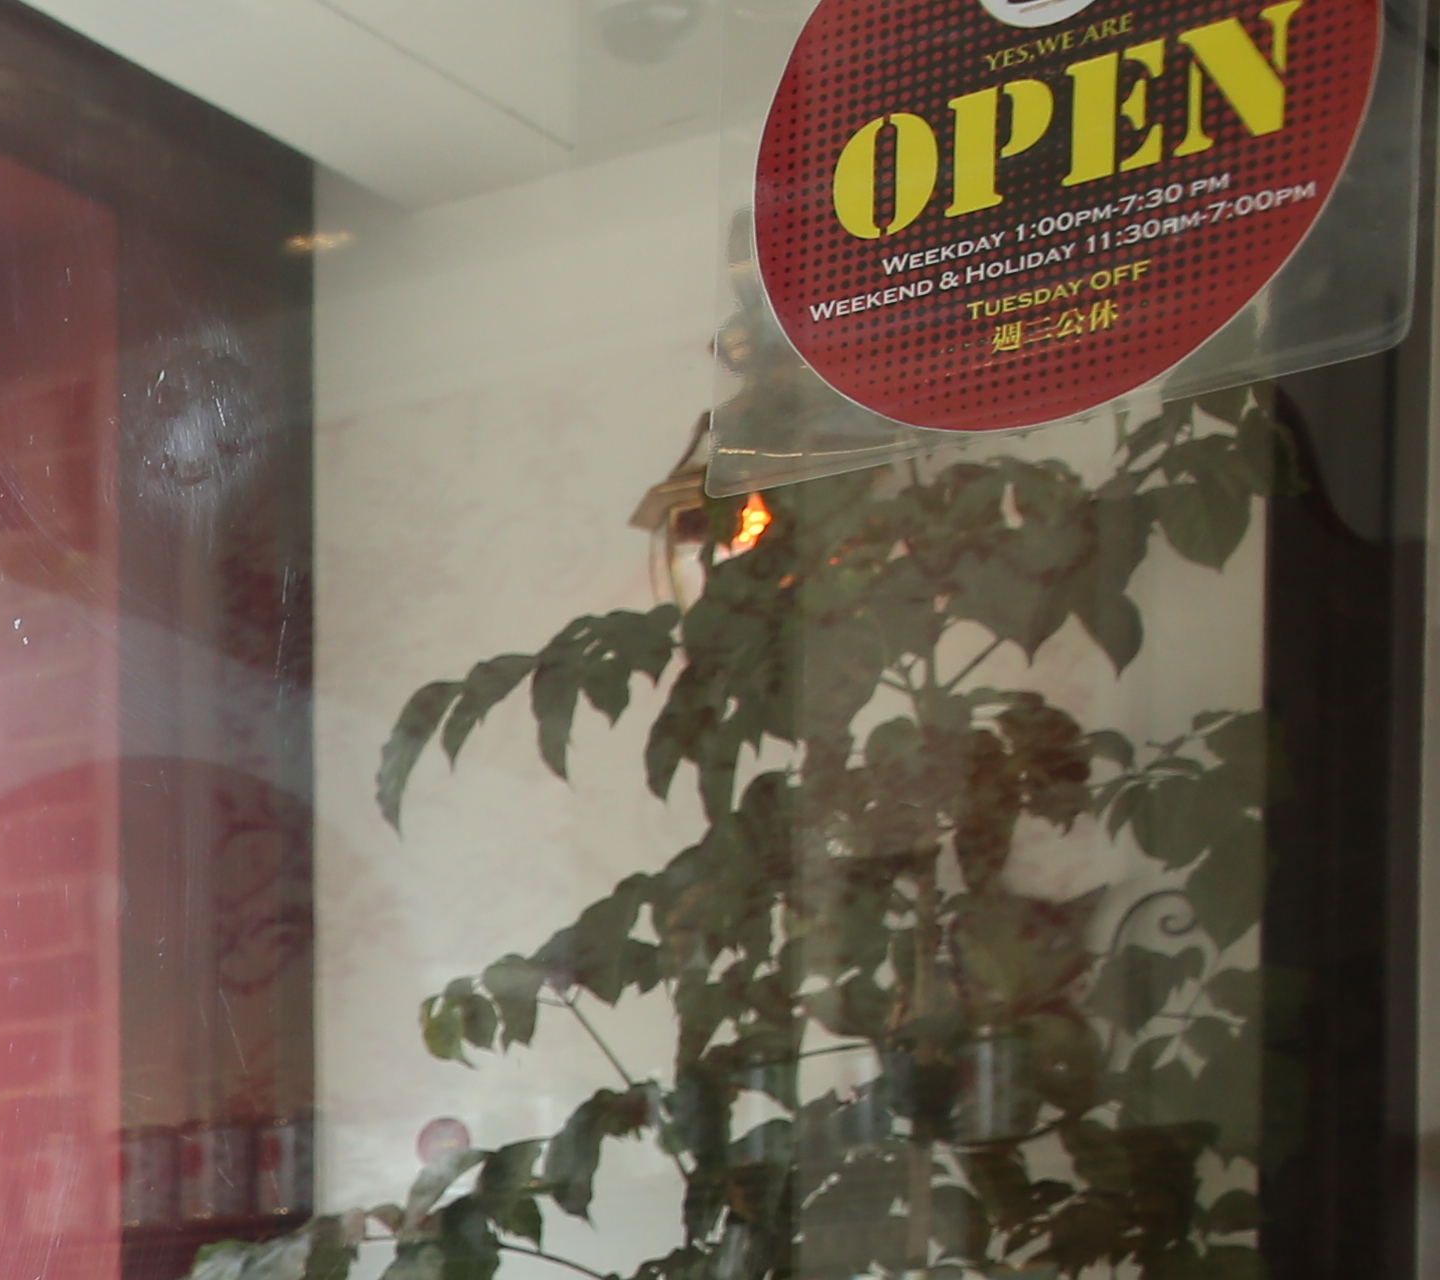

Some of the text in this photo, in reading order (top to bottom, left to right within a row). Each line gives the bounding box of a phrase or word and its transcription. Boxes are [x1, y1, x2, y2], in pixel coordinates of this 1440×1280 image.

[1080, 13, 1133, 45] ARE
[832, 0, 1303, 239] OPEN
[882, 231, 1005, 275] WEEKDAY
[1190, 172, 1230, 198] PM
[809, 279, 933, 323] WEEKEND
[939, 270, 959, 290] &
[966, 242, 1076, 285] HOLIDAY
[967, 259, 1151, 320] TUESDAY OFF
[992, 299, 1118, 354] 週二公休
